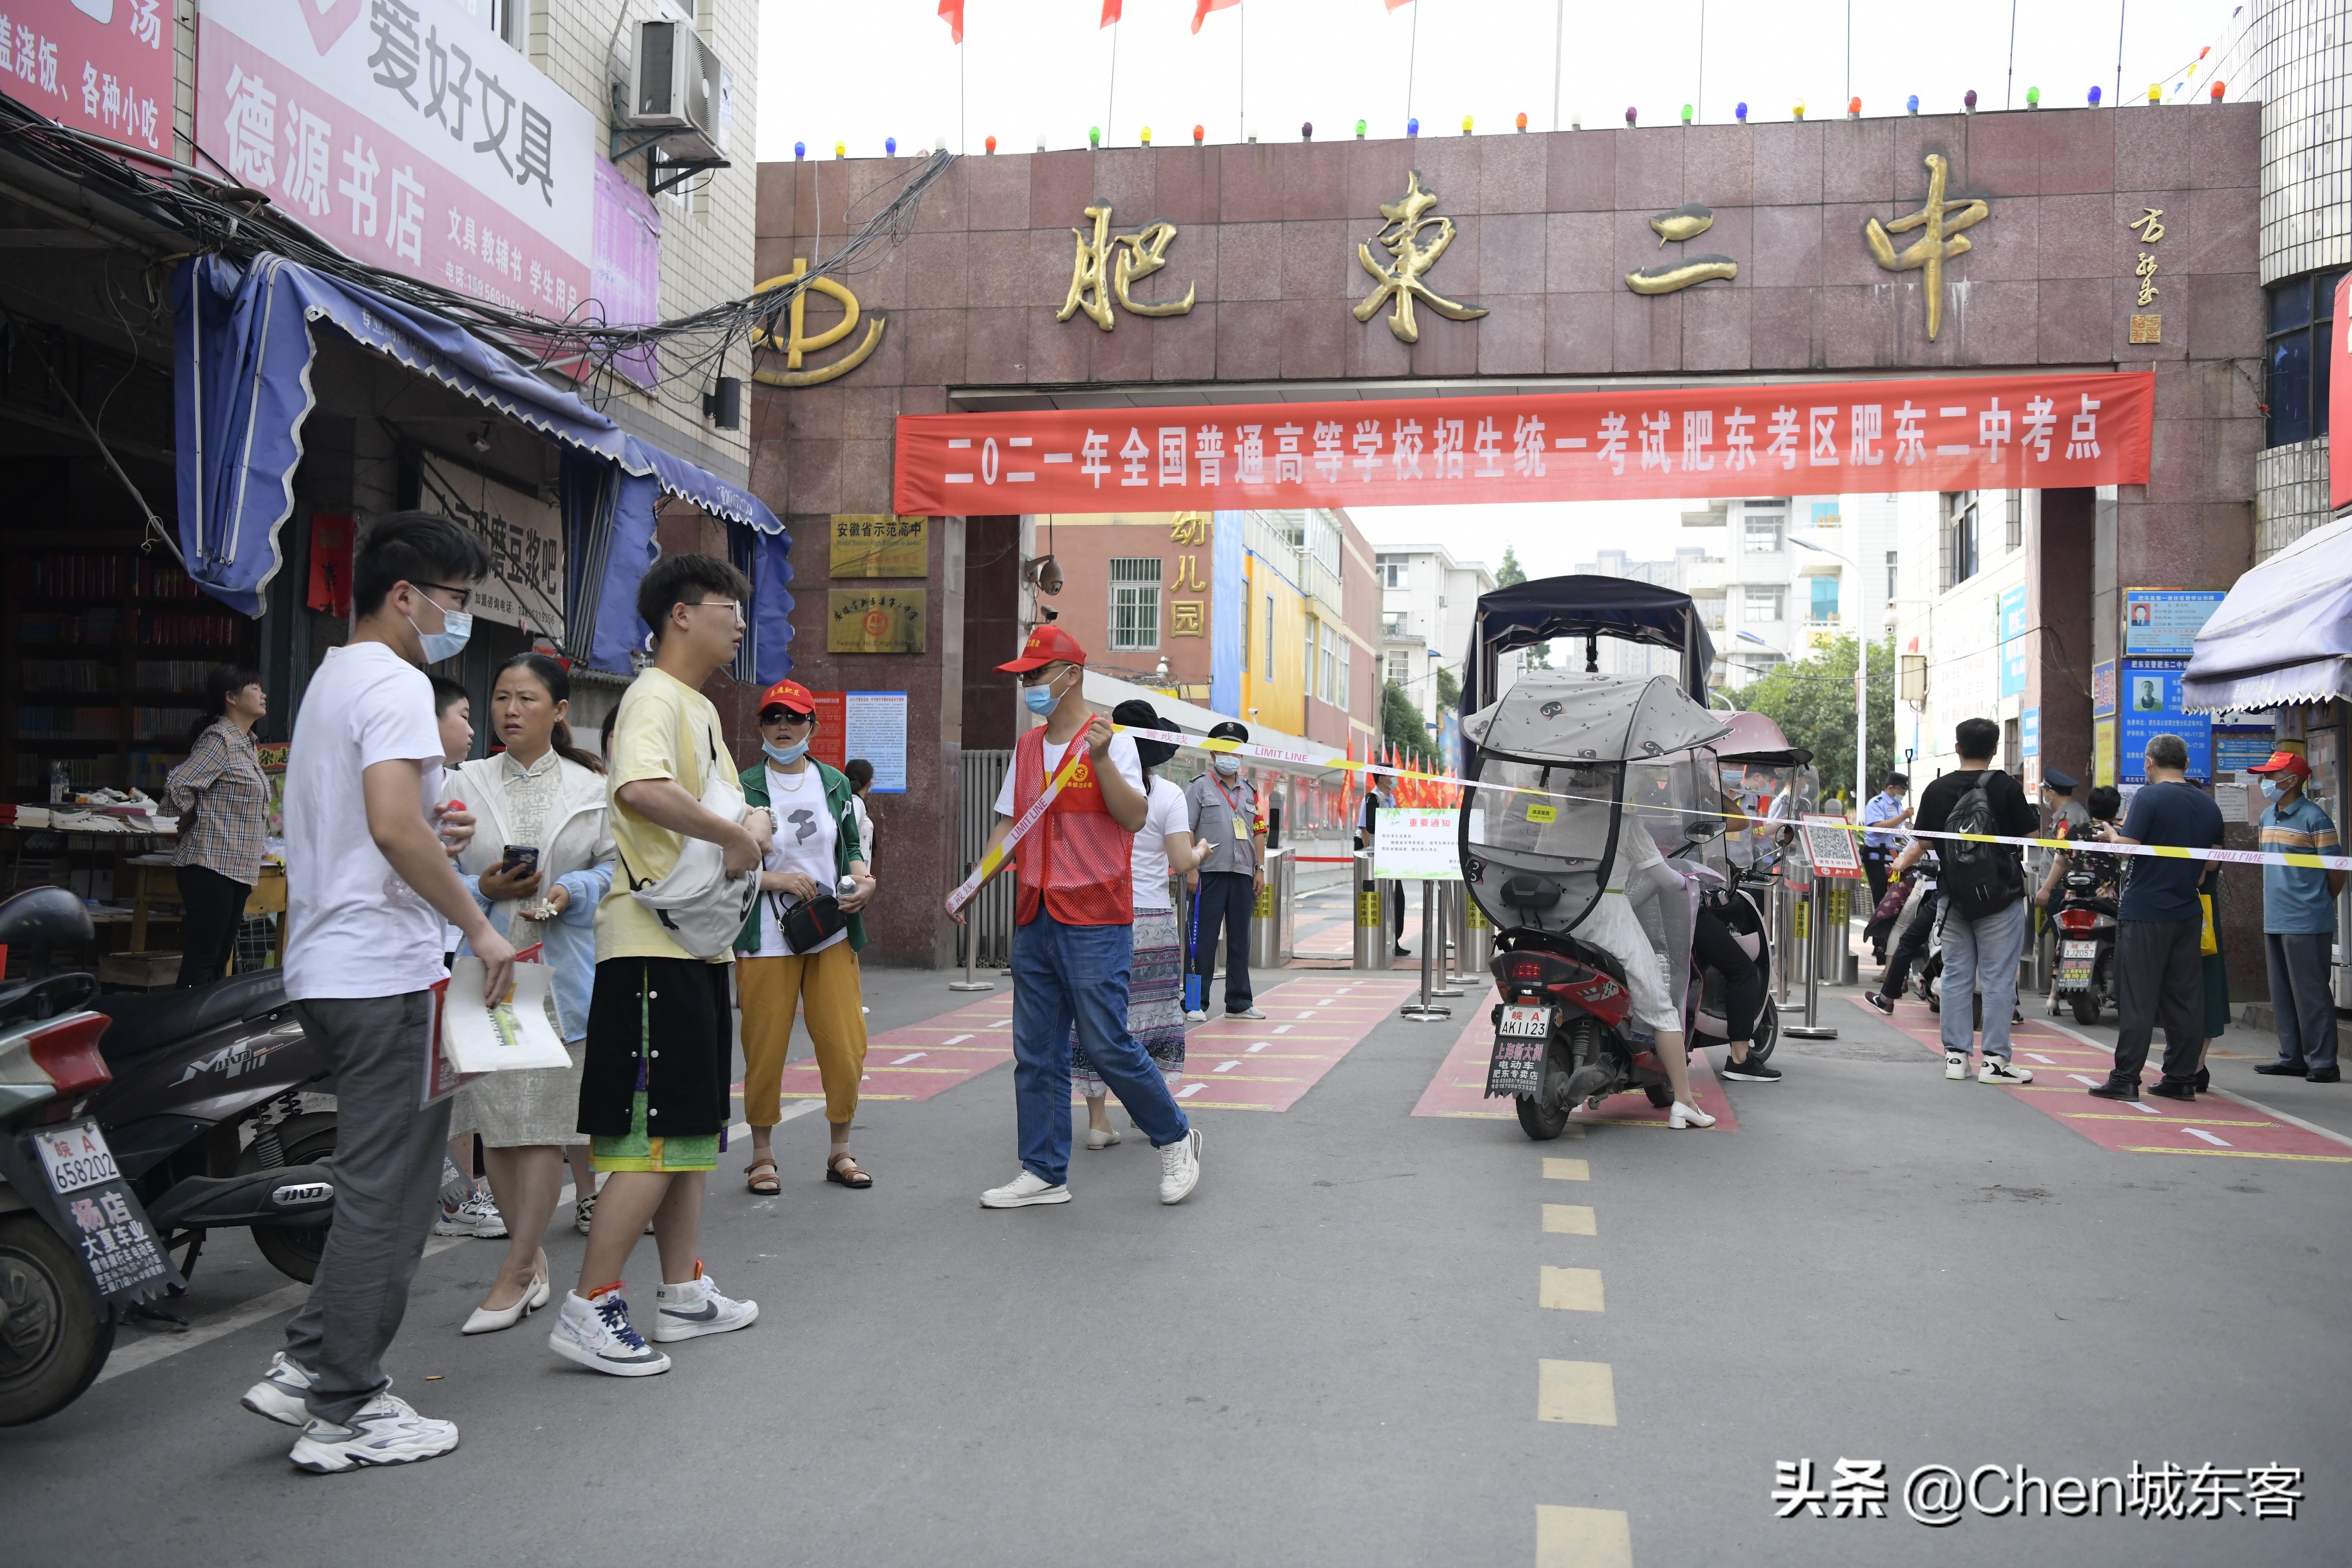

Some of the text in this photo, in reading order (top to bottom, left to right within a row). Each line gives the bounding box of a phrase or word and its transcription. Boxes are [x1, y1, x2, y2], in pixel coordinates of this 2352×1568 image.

[368, 0, 554, 207] 爱好文具
[224, 63, 427, 267] 德源书店
[447, 206, 578, 321] 文具 教辅书 学生用品
[838, 521, 921, 537] 安徽省示范高中
[1170, 511, 1206, 638] 幼儿园
[1145, 729, 1189, 744] 警戒线
[259, 748, 290, 765] 杂志
[1254, 746, 1308, 762] LIMIT LINE
[1010, 798, 1048, 841] LIMIT LINE
[1409, 818, 1451, 827] 重要通知
[948, 881, 975, 913] 警戒线
[1796, 904, 1805, 937] 禁止冲门
[1501, 1020, 1546, 1036] AK1123
[1512, 1011, 1540, 1022] 皖 A
[1495, 1042, 1544, 1061] 上海新大洲
[1492, 1069, 1538, 1080] 肥东专卖店
[1498, 1060, 1535, 1070] 电动车
[55, 1135, 96, 1158] 皖 A
[55, 1152, 117, 1189] 658202
[71, 1191, 133, 1234] 杨店
[81, 1220, 149, 1259] 大夏车业
